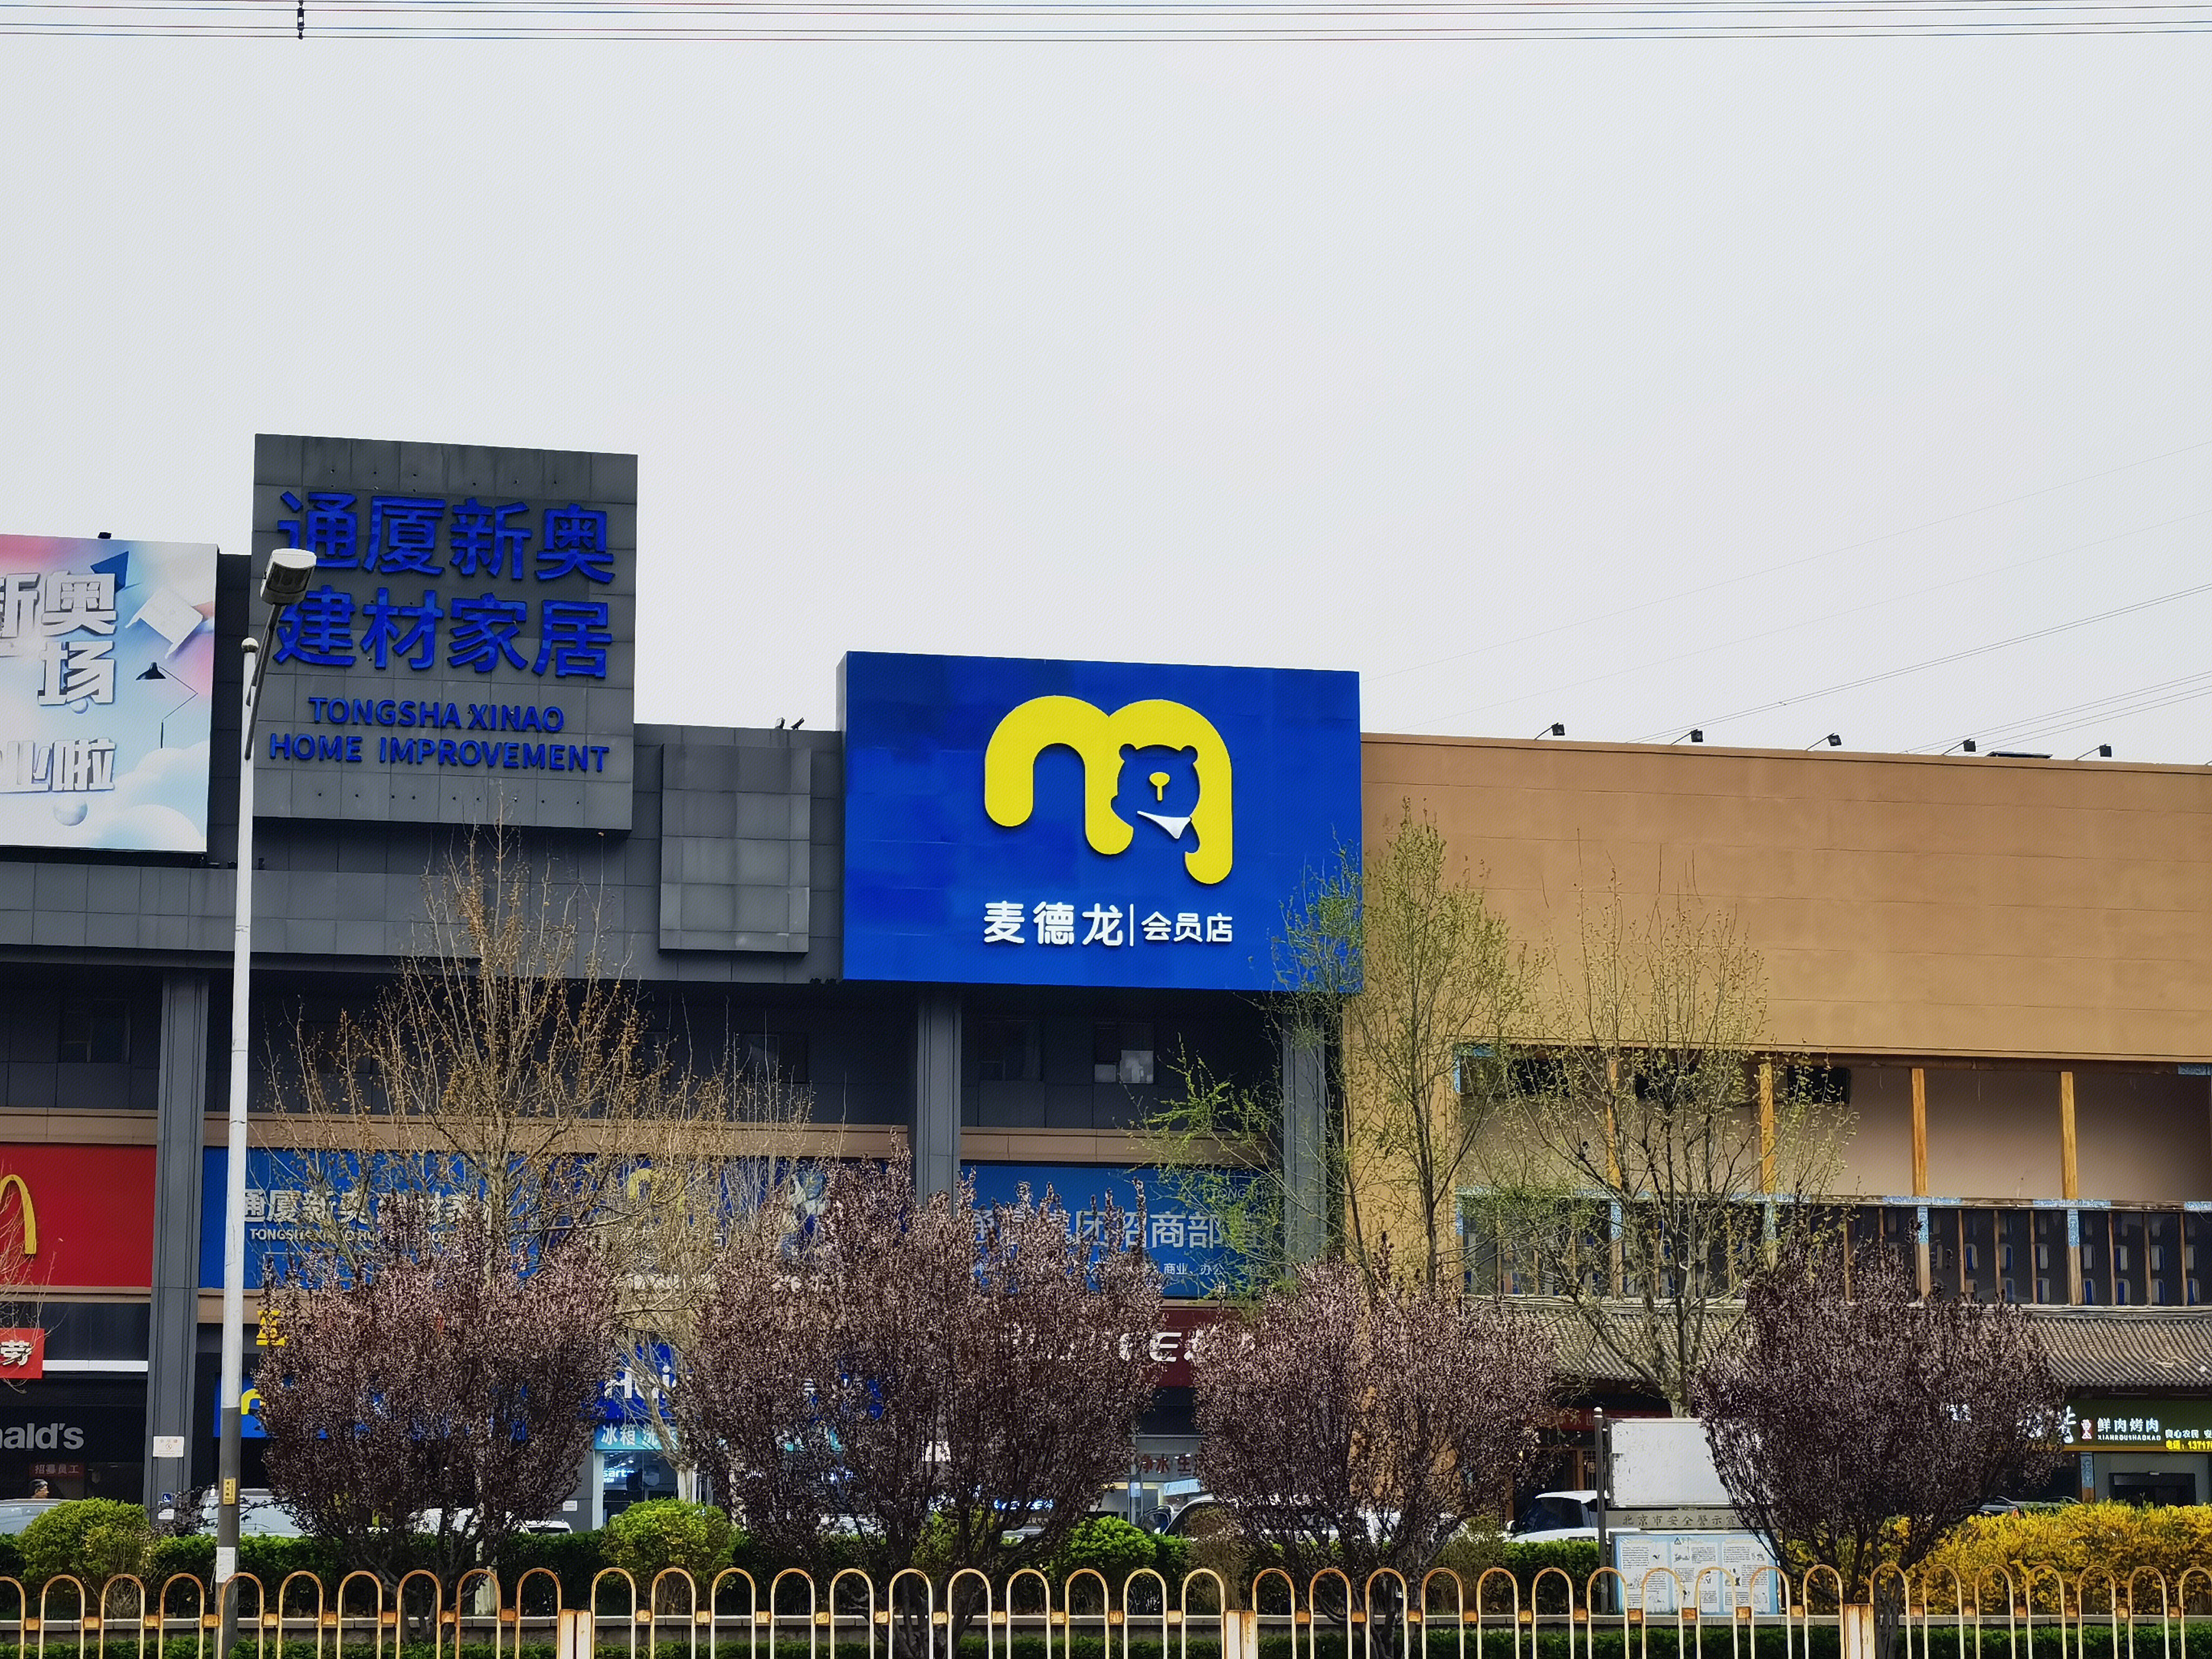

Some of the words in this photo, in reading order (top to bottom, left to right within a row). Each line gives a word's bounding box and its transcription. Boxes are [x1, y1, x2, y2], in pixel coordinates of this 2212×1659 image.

[277, 491, 615, 584] 通厦新奥
[272, 584, 612, 679] 建材家居
[308, 696, 462, 729] TONGSHA
[468, 704, 565, 733] XINAO
[269, 733, 363, 762] HOME
[379, 737, 610, 772] IMPROVEMENT
[983, 901, 1123, 946] 麦德龙
[1141, 911, 1233, 943] 会员店
[0, 1422, 84, 1450] ald's
[2097, 1417, 2159, 1433] 鲜肉烤肉
[1622, 1514, 1754, 1527] 北京市安全警示宣
